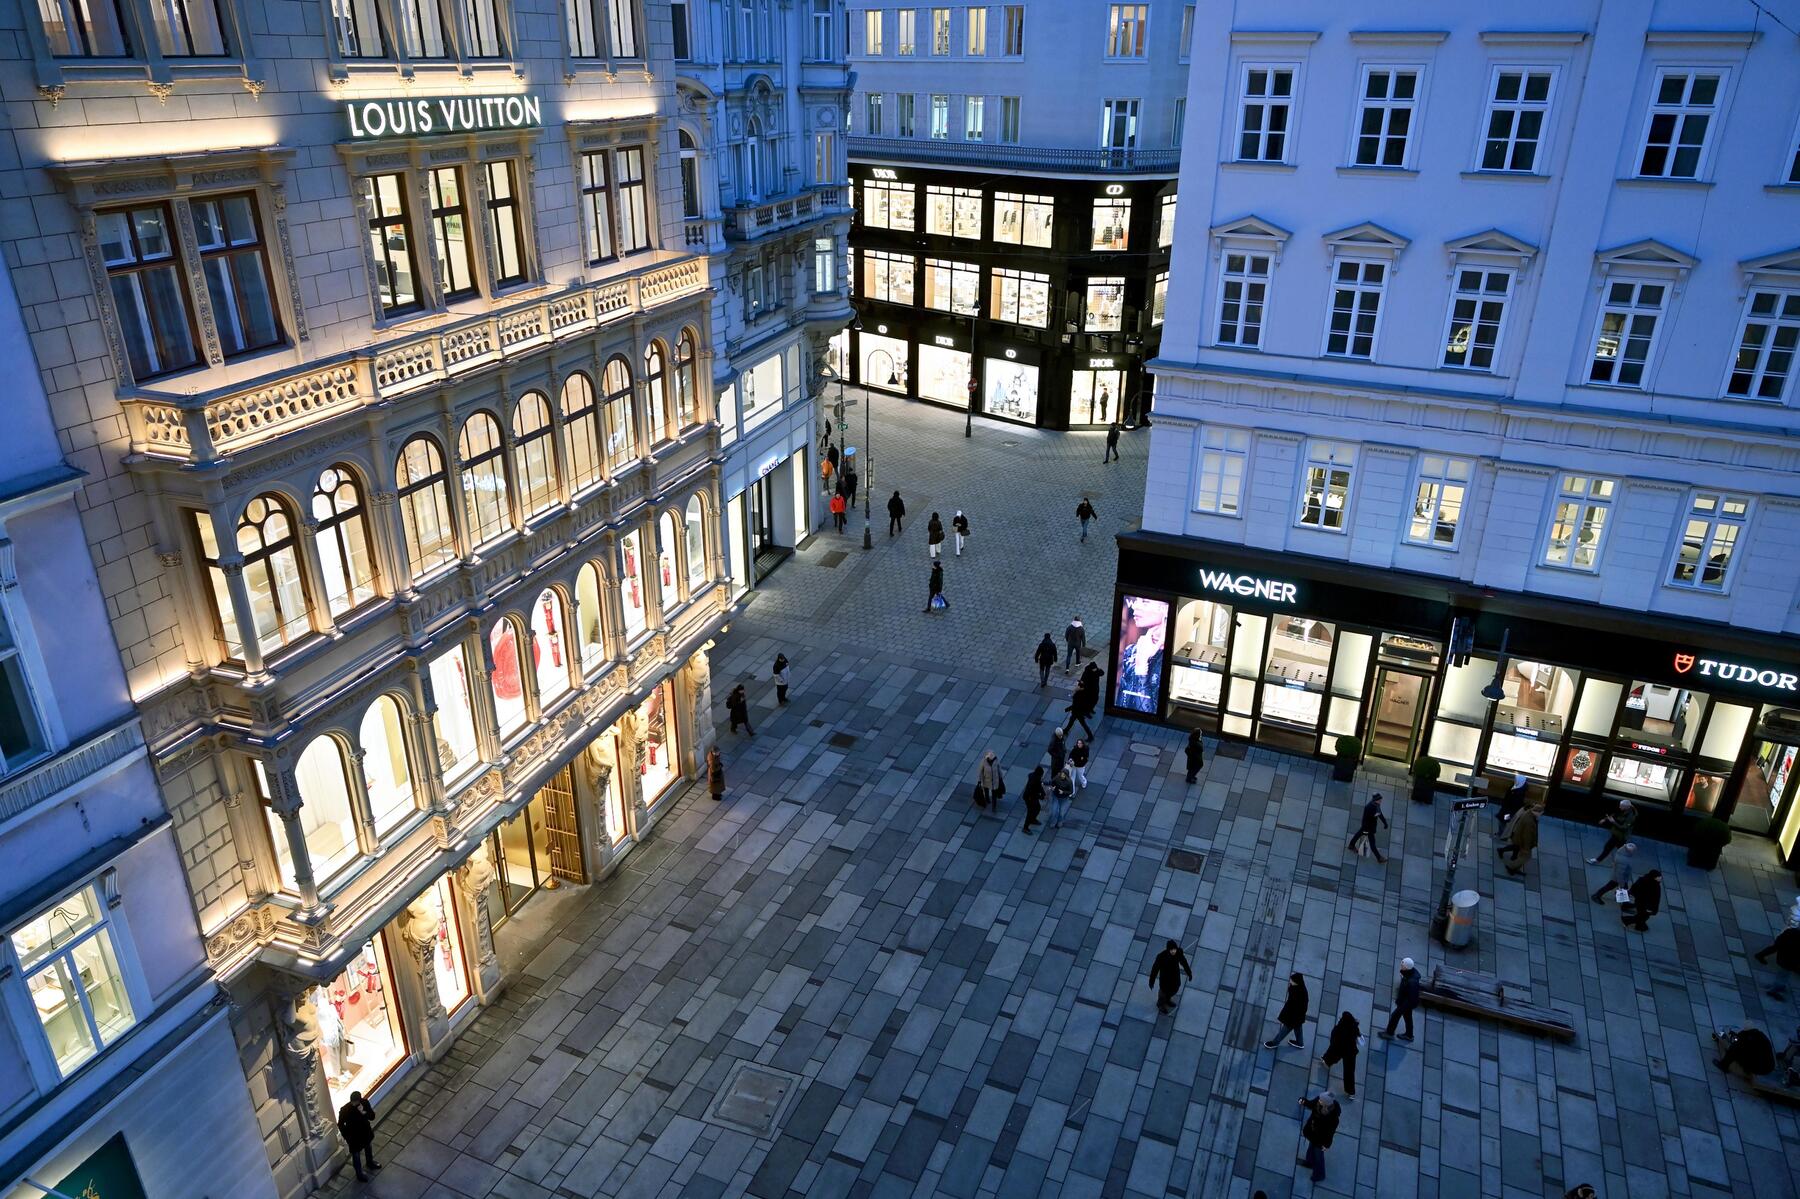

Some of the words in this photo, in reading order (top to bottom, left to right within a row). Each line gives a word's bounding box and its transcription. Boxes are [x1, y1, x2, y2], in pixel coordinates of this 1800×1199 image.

[348, 101, 432, 136] LOUIS
[439, 96, 541, 131] VUITTON
[1089, 358, 1114, 368] DIOR
[1199, 568, 1297, 603] WAGNER
[1699, 658, 1798, 691] TUDOR
[1638, 744, 1660, 753] TUDOR
